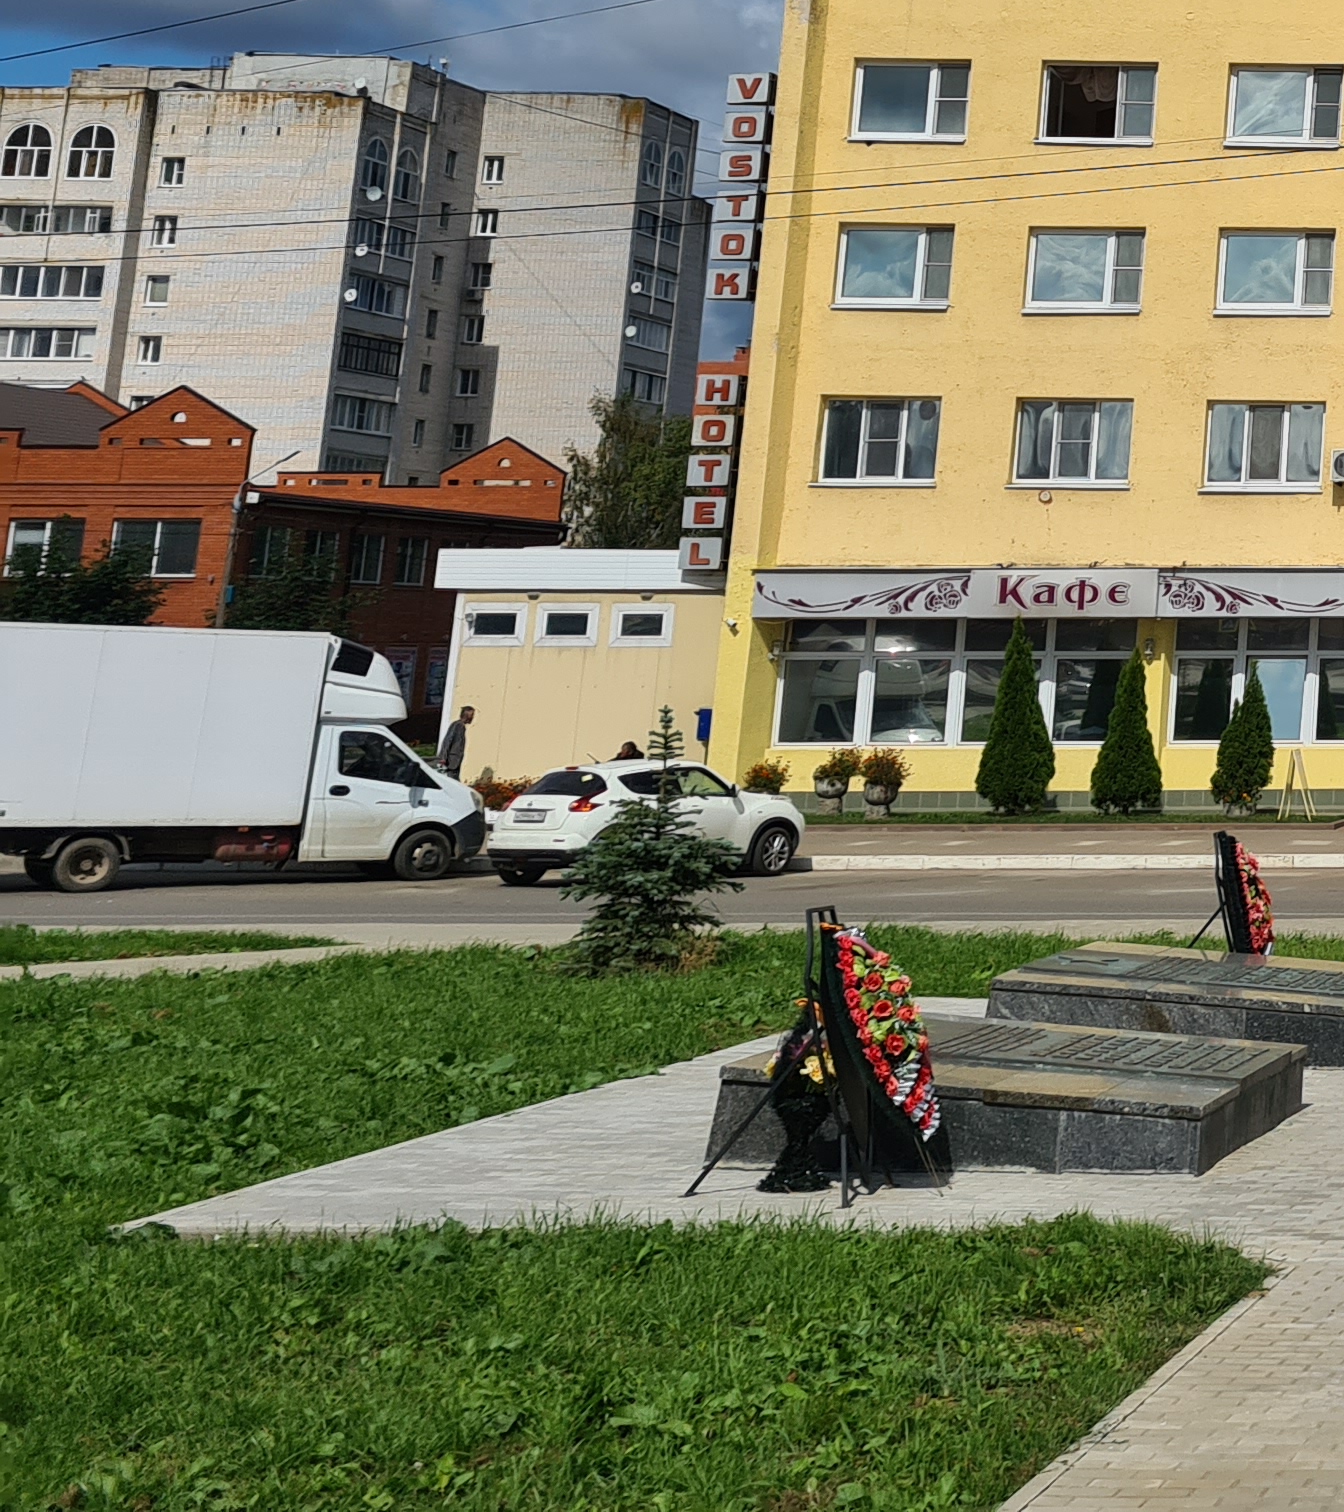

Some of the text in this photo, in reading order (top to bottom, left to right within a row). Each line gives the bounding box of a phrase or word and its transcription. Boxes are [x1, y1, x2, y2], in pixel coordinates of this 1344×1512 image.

[714, 77, 763, 295] VOSTOK
[689, 378, 732, 566] HOTEL
[995, 575, 1131, 611] Кафе
